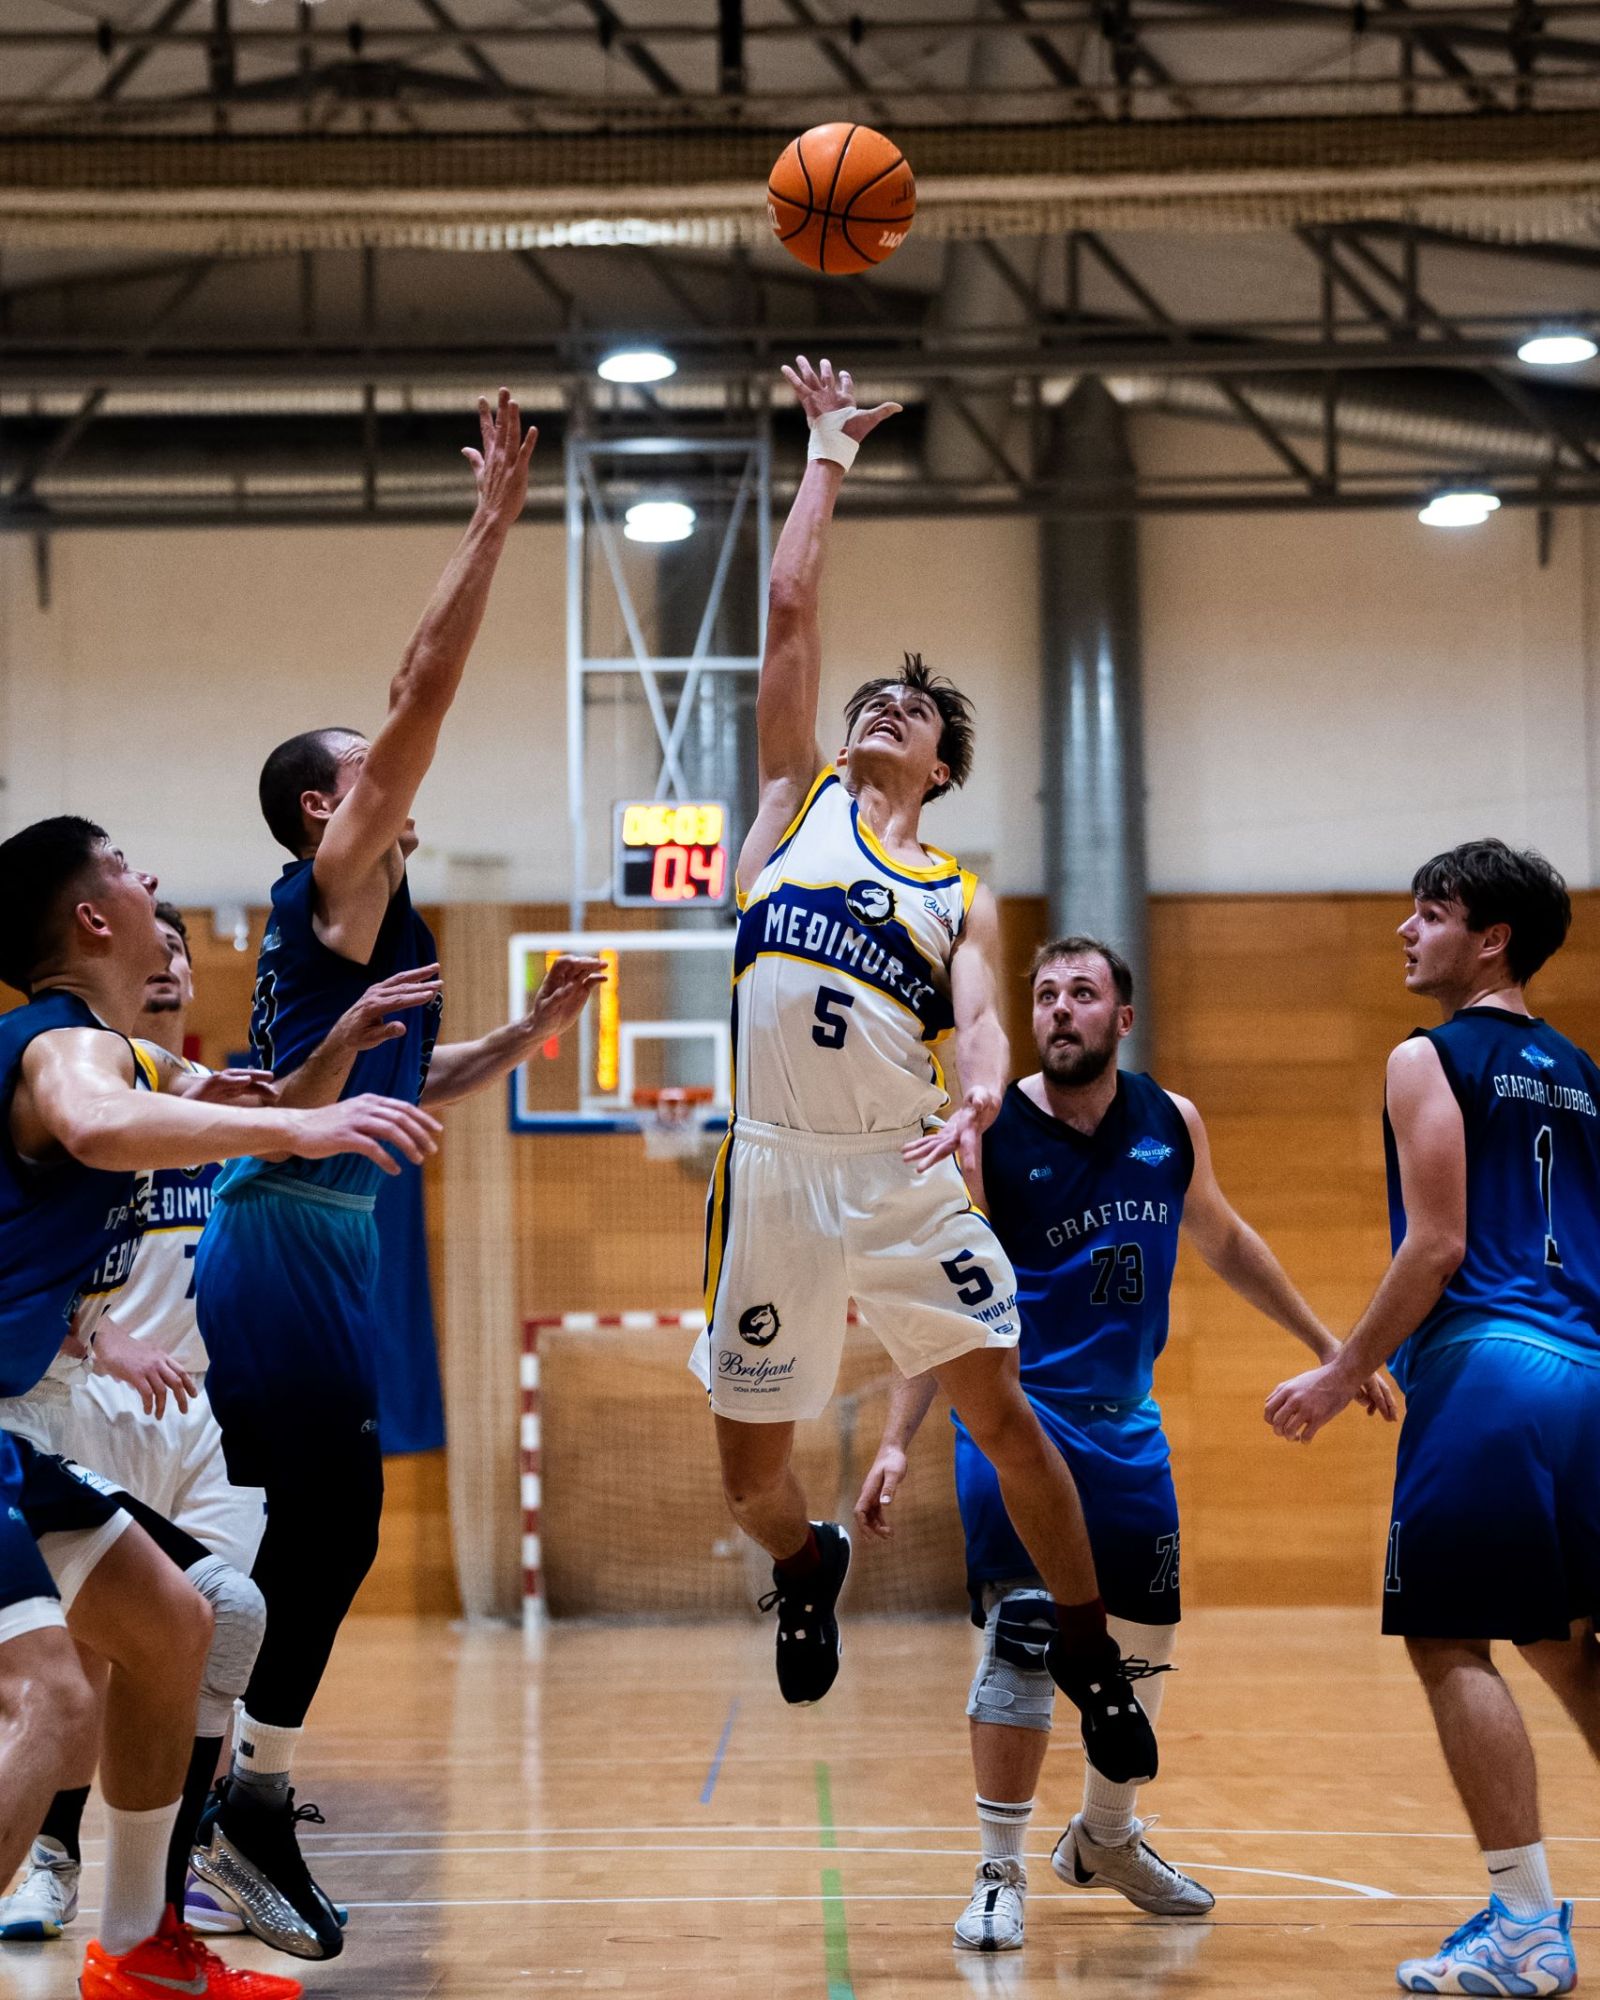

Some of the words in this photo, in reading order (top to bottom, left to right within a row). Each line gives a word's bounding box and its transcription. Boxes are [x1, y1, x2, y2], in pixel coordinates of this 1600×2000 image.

[651, 846, 727, 902] 0.4
[811, 984, 855, 1050] 5
[1045, 1200, 1169, 1248] GRAFICAR
[940, 1249, 994, 1306] 5
[1090, 1242, 1145, 1305] 73
[718, 1350, 798, 1385] Briljant
[1385, 1521, 1401, 1592] 1
